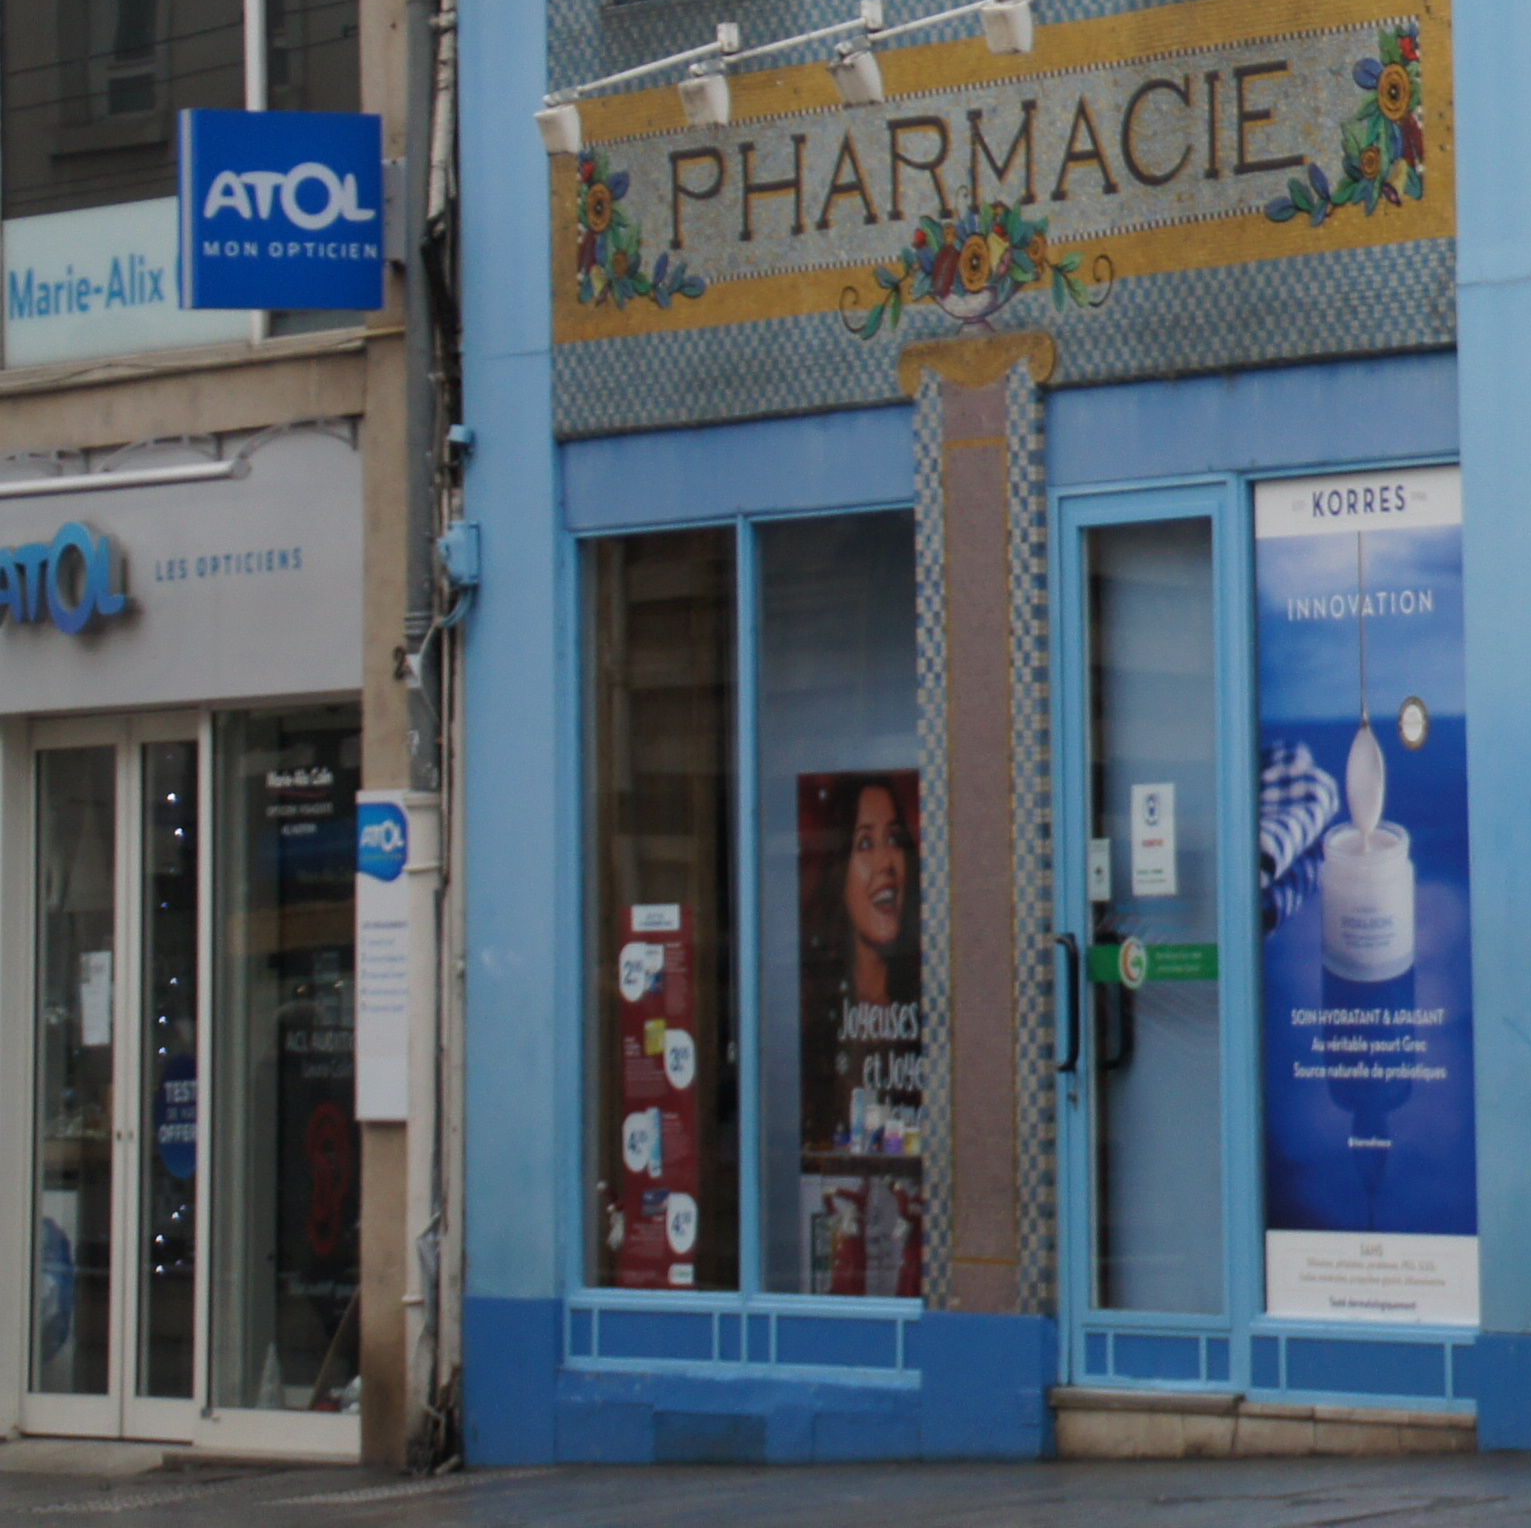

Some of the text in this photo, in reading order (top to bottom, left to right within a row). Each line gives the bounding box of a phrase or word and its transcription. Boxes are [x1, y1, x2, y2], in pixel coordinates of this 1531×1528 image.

[668, 60, 1306, 251] PHARMACIE
[203, 162, 376, 230] ATOL
[203, 241, 379, 259] MON OPTICIEN
[8, 253, 164, 320] Marie-Alix
[1312, 485, 1406, 517] KORRES
[155, 547, 303, 582] LES OPTICIENS
[1287, 590, 1433, 621] INNOVATION
[837, 997, 918, 1042] Joyeuses
[1291, 1008, 1317, 1025] SOIN
[1319, 1008, 1381, 1024] HYDRATANT
[1392, 1008, 1445, 1024] APAISANT
[1311, 1036, 1325, 1051] Au
[1370, 1037, 1400, 1054] yaourt
[1293, 1061, 1326, 1078] Source
[1371, 1062, 1383, 1078] de
